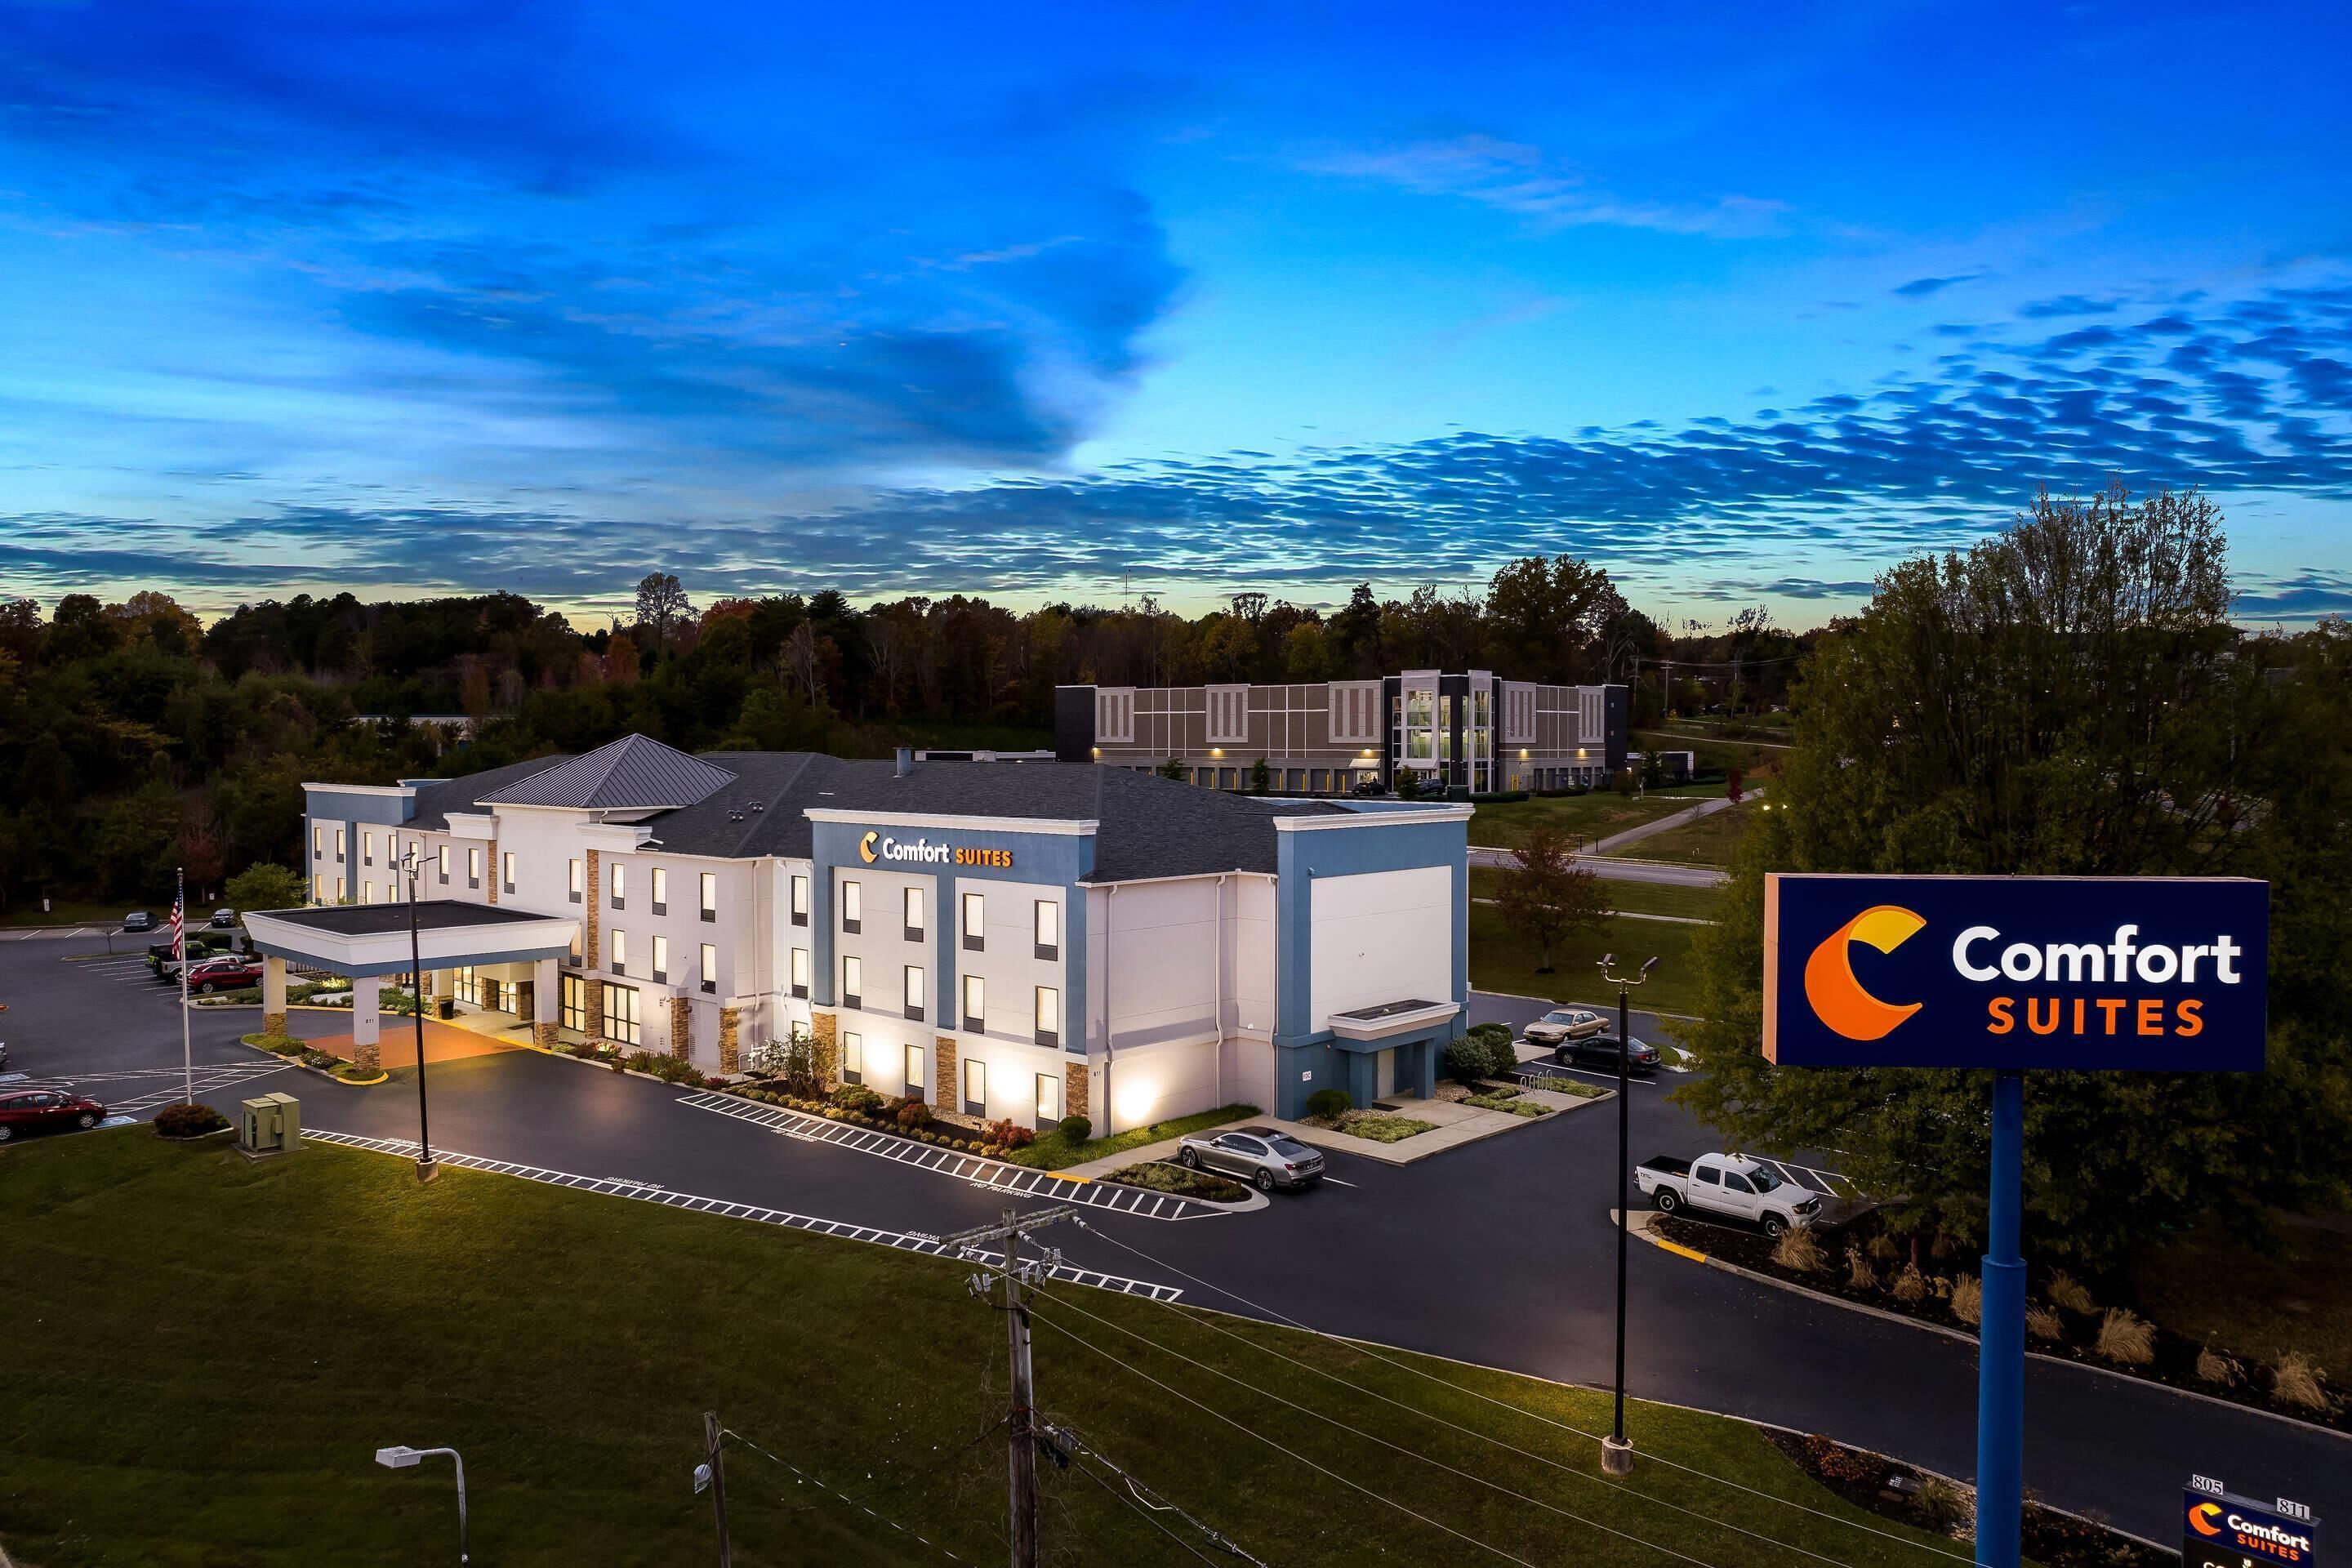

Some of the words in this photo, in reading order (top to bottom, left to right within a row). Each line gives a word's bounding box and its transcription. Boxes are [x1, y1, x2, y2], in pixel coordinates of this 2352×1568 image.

[883, 838, 950, 863] Comfort
[956, 849, 1013, 867] SUITES
[1953, 924, 2241, 984] Comfort
[1986, 997, 2204, 1036] SUITES
[987, 1186, 1034, 1198] PARKING
[2194, 1476, 2221, 1494] 805
[2279, 1499, 2310, 1519] 811
[2227, 1514, 2310, 1552] Comfort
[2237, 1533, 2300, 1561] SUITES
